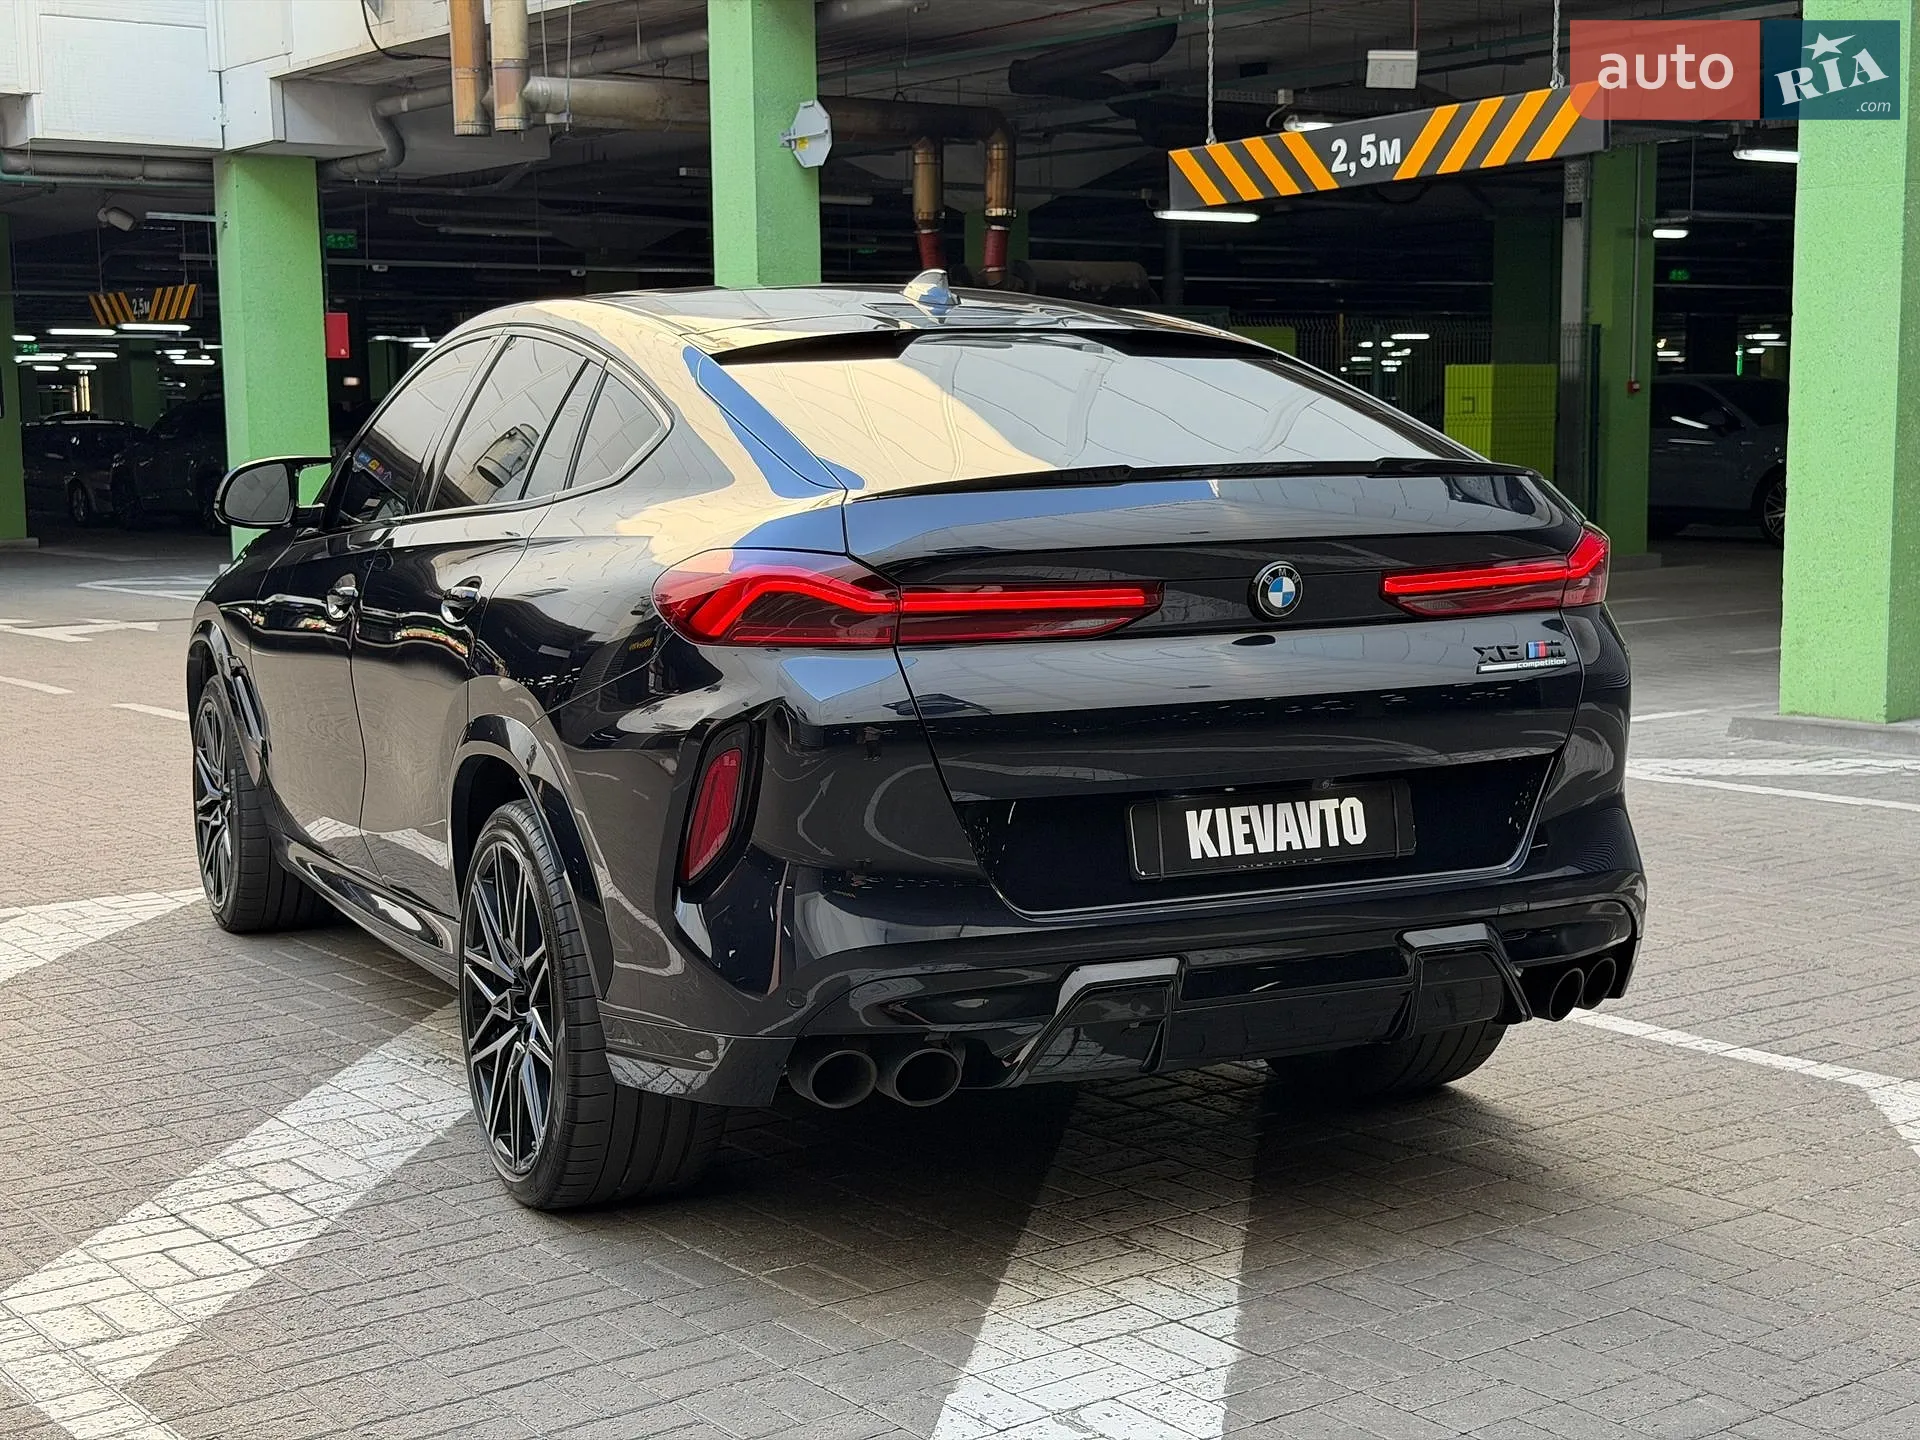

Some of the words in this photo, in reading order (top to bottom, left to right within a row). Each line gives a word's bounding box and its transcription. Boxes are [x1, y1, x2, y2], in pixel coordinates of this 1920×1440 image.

[1263, 568, 1300, 585] BMW
[1517, 658, 1567, 668] competition
[1185, 796, 1368, 860] KIEVAVTO
